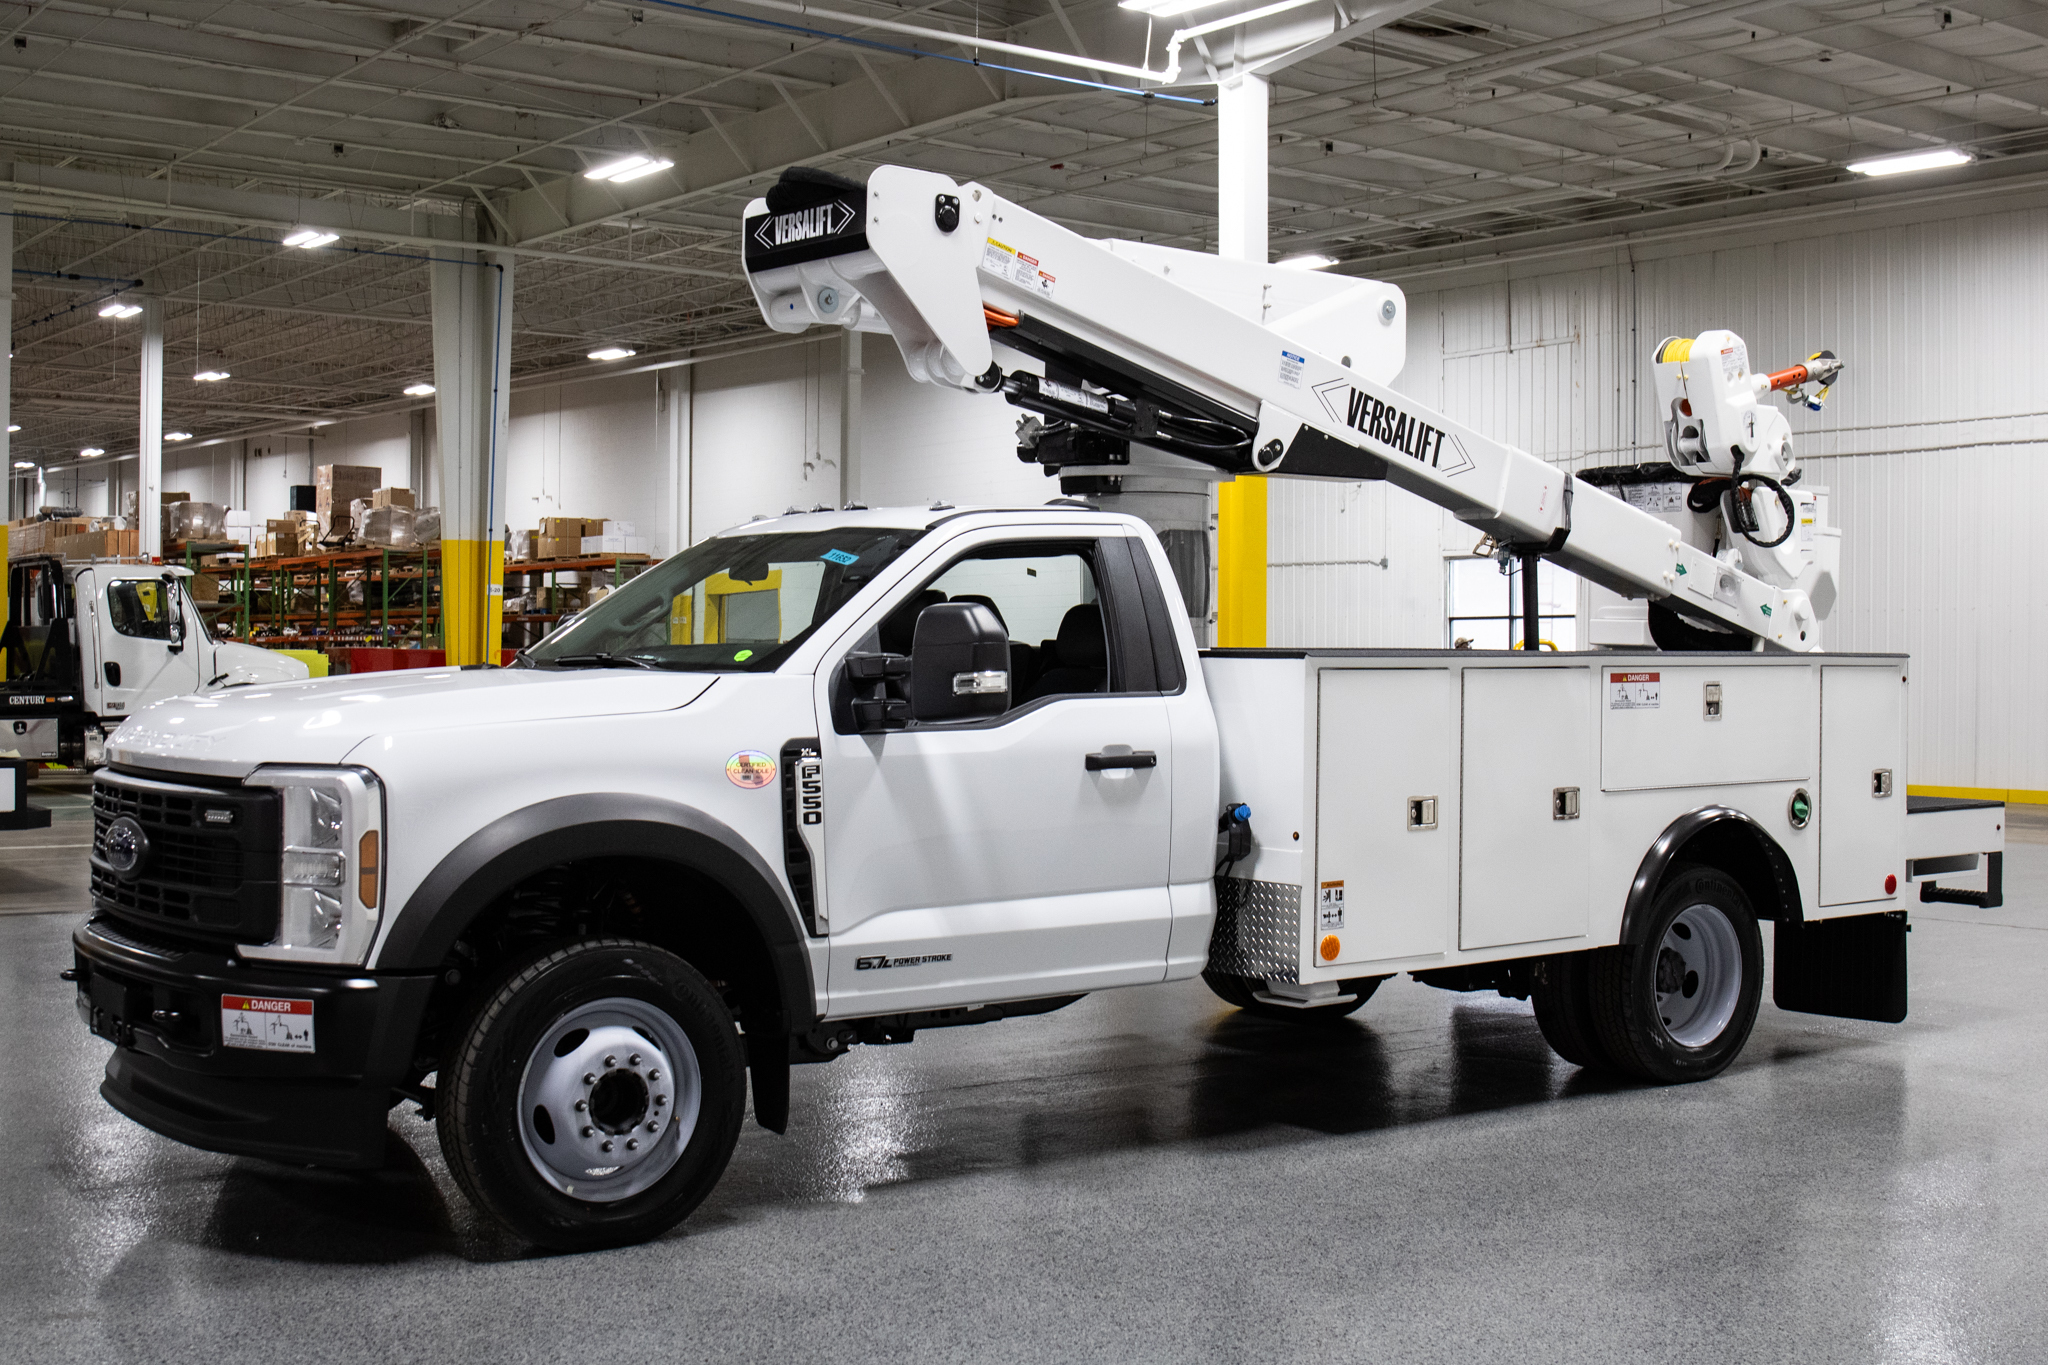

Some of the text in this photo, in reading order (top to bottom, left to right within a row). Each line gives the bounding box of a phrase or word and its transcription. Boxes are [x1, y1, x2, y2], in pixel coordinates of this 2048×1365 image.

[774, 203, 834, 245] VERSALIFT
[995, 241, 1013, 253] CAUTION
[1346, 386, 1446, 468] VERSALIFT
[1627, 674, 1650, 682] DANGER
[9, 695, 46, 705] CENTURY
[801, 747, 818, 757] XL
[801, 765, 822, 825] F550
[893, 956, 921, 965] POWER
[922, 953, 952, 963] STROKE
[251, 999, 292, 1012] DANGER
